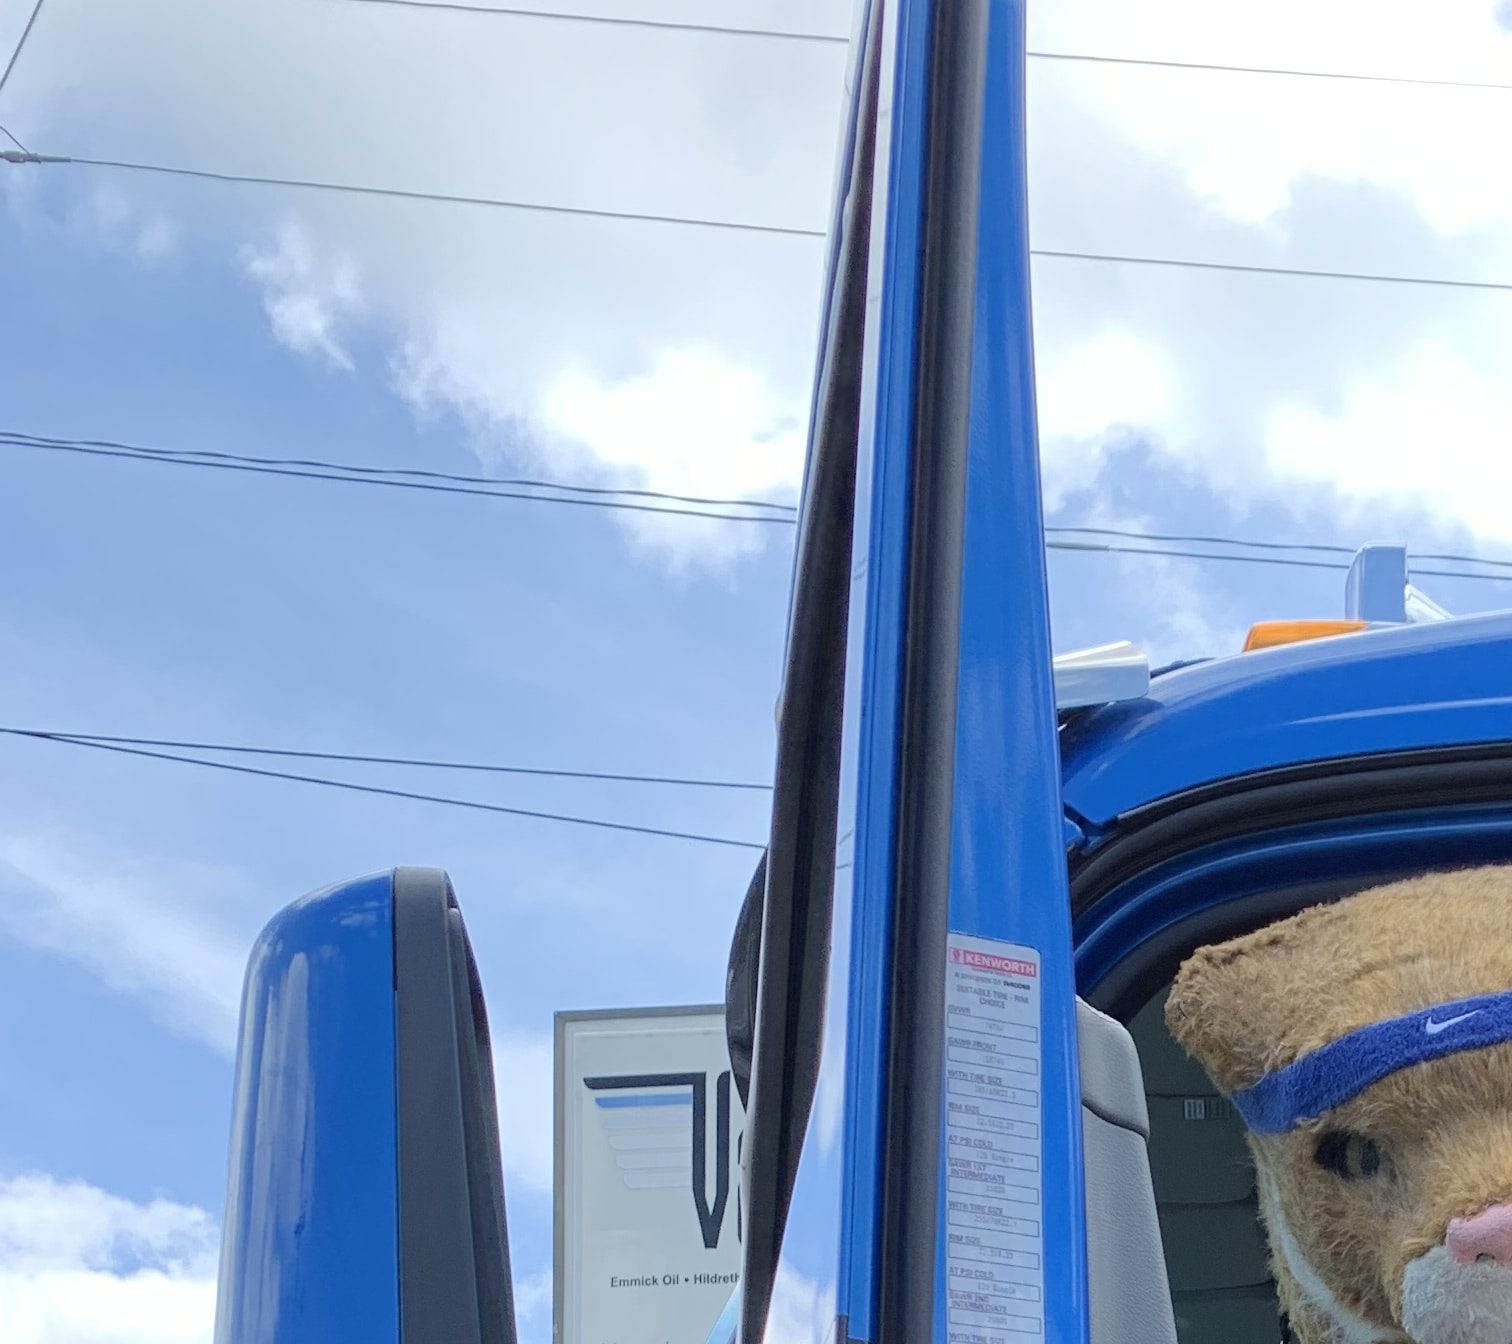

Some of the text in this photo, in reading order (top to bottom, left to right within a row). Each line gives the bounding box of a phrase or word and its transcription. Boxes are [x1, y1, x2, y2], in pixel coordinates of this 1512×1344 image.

[964, 952, 1035, 976] KENWORTH
[610, 1275, 659, 1288] Emmick
[663, 1274, 679, 1285] Oil
